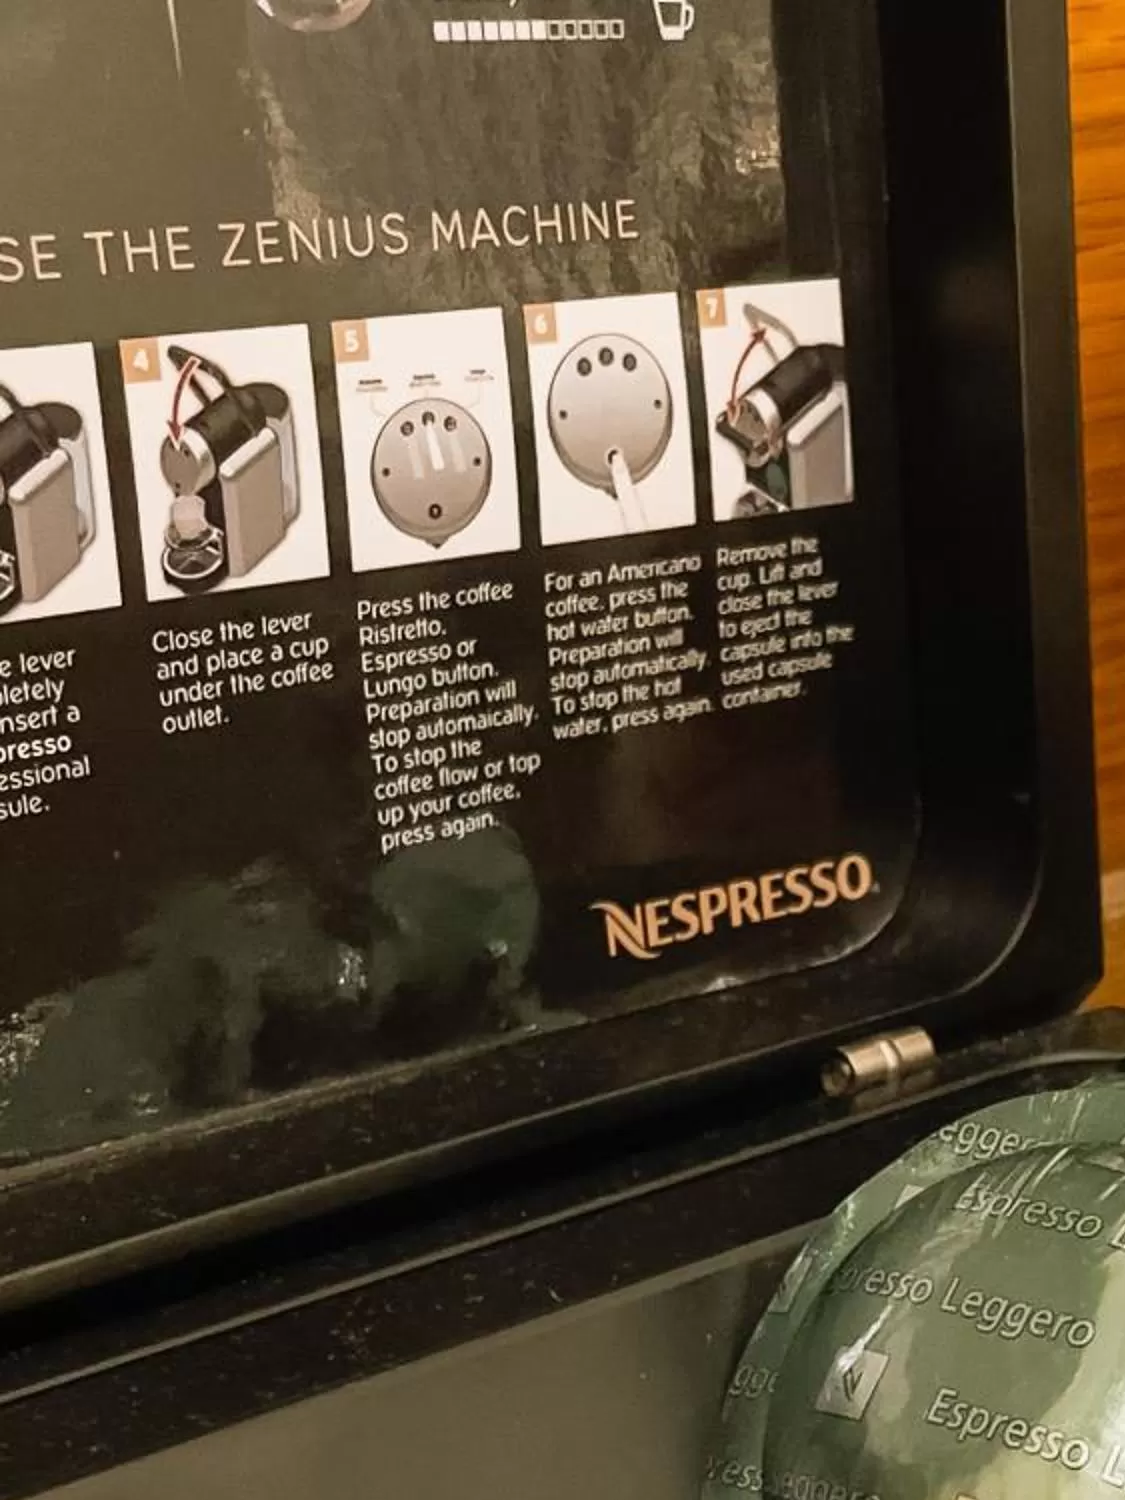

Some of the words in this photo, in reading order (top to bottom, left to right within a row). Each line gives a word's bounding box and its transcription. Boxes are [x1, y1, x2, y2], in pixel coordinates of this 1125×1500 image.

[82, 225, 196, 277] THE
[217, 211, 409, 270] ZENIUS
[431, 199, 639, 251] MACHINE
[534, 313, 548, 335] 6
[707, 296, 720, 319] 7
[343, 330, 360, 353] 5
[132, 347, 150, 373] 4
[716, 540, 788, 568] Remove
[790, 536, 820, 556] the
[788, 557, 823, 581] and
[543, 572, 574, 594] For
[578, 568, 603, 589] an
[607, 555, 703, 584] Americano
[357, 597, 413, 620] Press
[420, 592, 450, 612] the
[456, 582, 513, 607] coffee
[609, 587, 657, 614] press
[660, 579, 689, 601] the
[717, 593, 763, 617] close
[767, 587, 795, 608] the
[798, 580, 840, 602] lever
[151, 626, 213, 654] Close
[219, 620, 256, 643] the
[260, 611, 313, 637] lever
[547, 620, 575, 643] hot
[580, 613, 629, 638] water
[719, 620, 737, 640] to
[784, 607, 813, 628] the
[19, 648, 76, 674] lever
[156, 654, 199, 682] and
[205, 646, 265, 675] place
[270, 644, 284, 662] a
[289, 637, 330, 661] cup
[362, 643, 451, 674] Espresso
[457, 638, 478, 657] or
[548, 636, 651, 668] Preparation
[654, 627, 685, 649] will
[719, 636, 787, 664] capsule
[789, 628, 823, 650] into
[826, 623, 855, 644] the
[159, 680, 225, 708] under
[230, 672, 265, 695] the
[270, 661, 335, 689] coffee
[363, 672, 426, 700] Lungo
[550, 669, 589, 693] stop
[721, 662, 764, 687] used
[767, 651, 834, 679] capsule
[366, 688, 480, 724] Preparation
[485, 680, 517, 703] will
[553, 695, 575, 717] To
[579, 687, 620, 712] stop
[622, 680, 651, 702] the
[654, 675, 682, 698] hot
[67, 706, 81, 723] a
[611, 706, 659, 734] press
[369, 727, 411, 751] stop
[372, 754, 398, 776] To
[404, 747, 446, 771] stop
[451, 738, 483, 759] the
[0, 755, 91, 791] essional
[374, 773, 433, 801] coffee
[439, 765, 479, 787] flow
[484, 760, 504, 779] or
[509, 752, 541, 775] top
[377, 806, 404, 828] up
[409, 795, 452, 824] your
[381, 824, 435, 855] press
[588, 853, 873, 959] NESPRESSO
[954, 1172, 1103, 1238] Espresso
[940, 1277, 1096, 1347] Leggero
[926, 1387, 1091, 1472] Espresso
